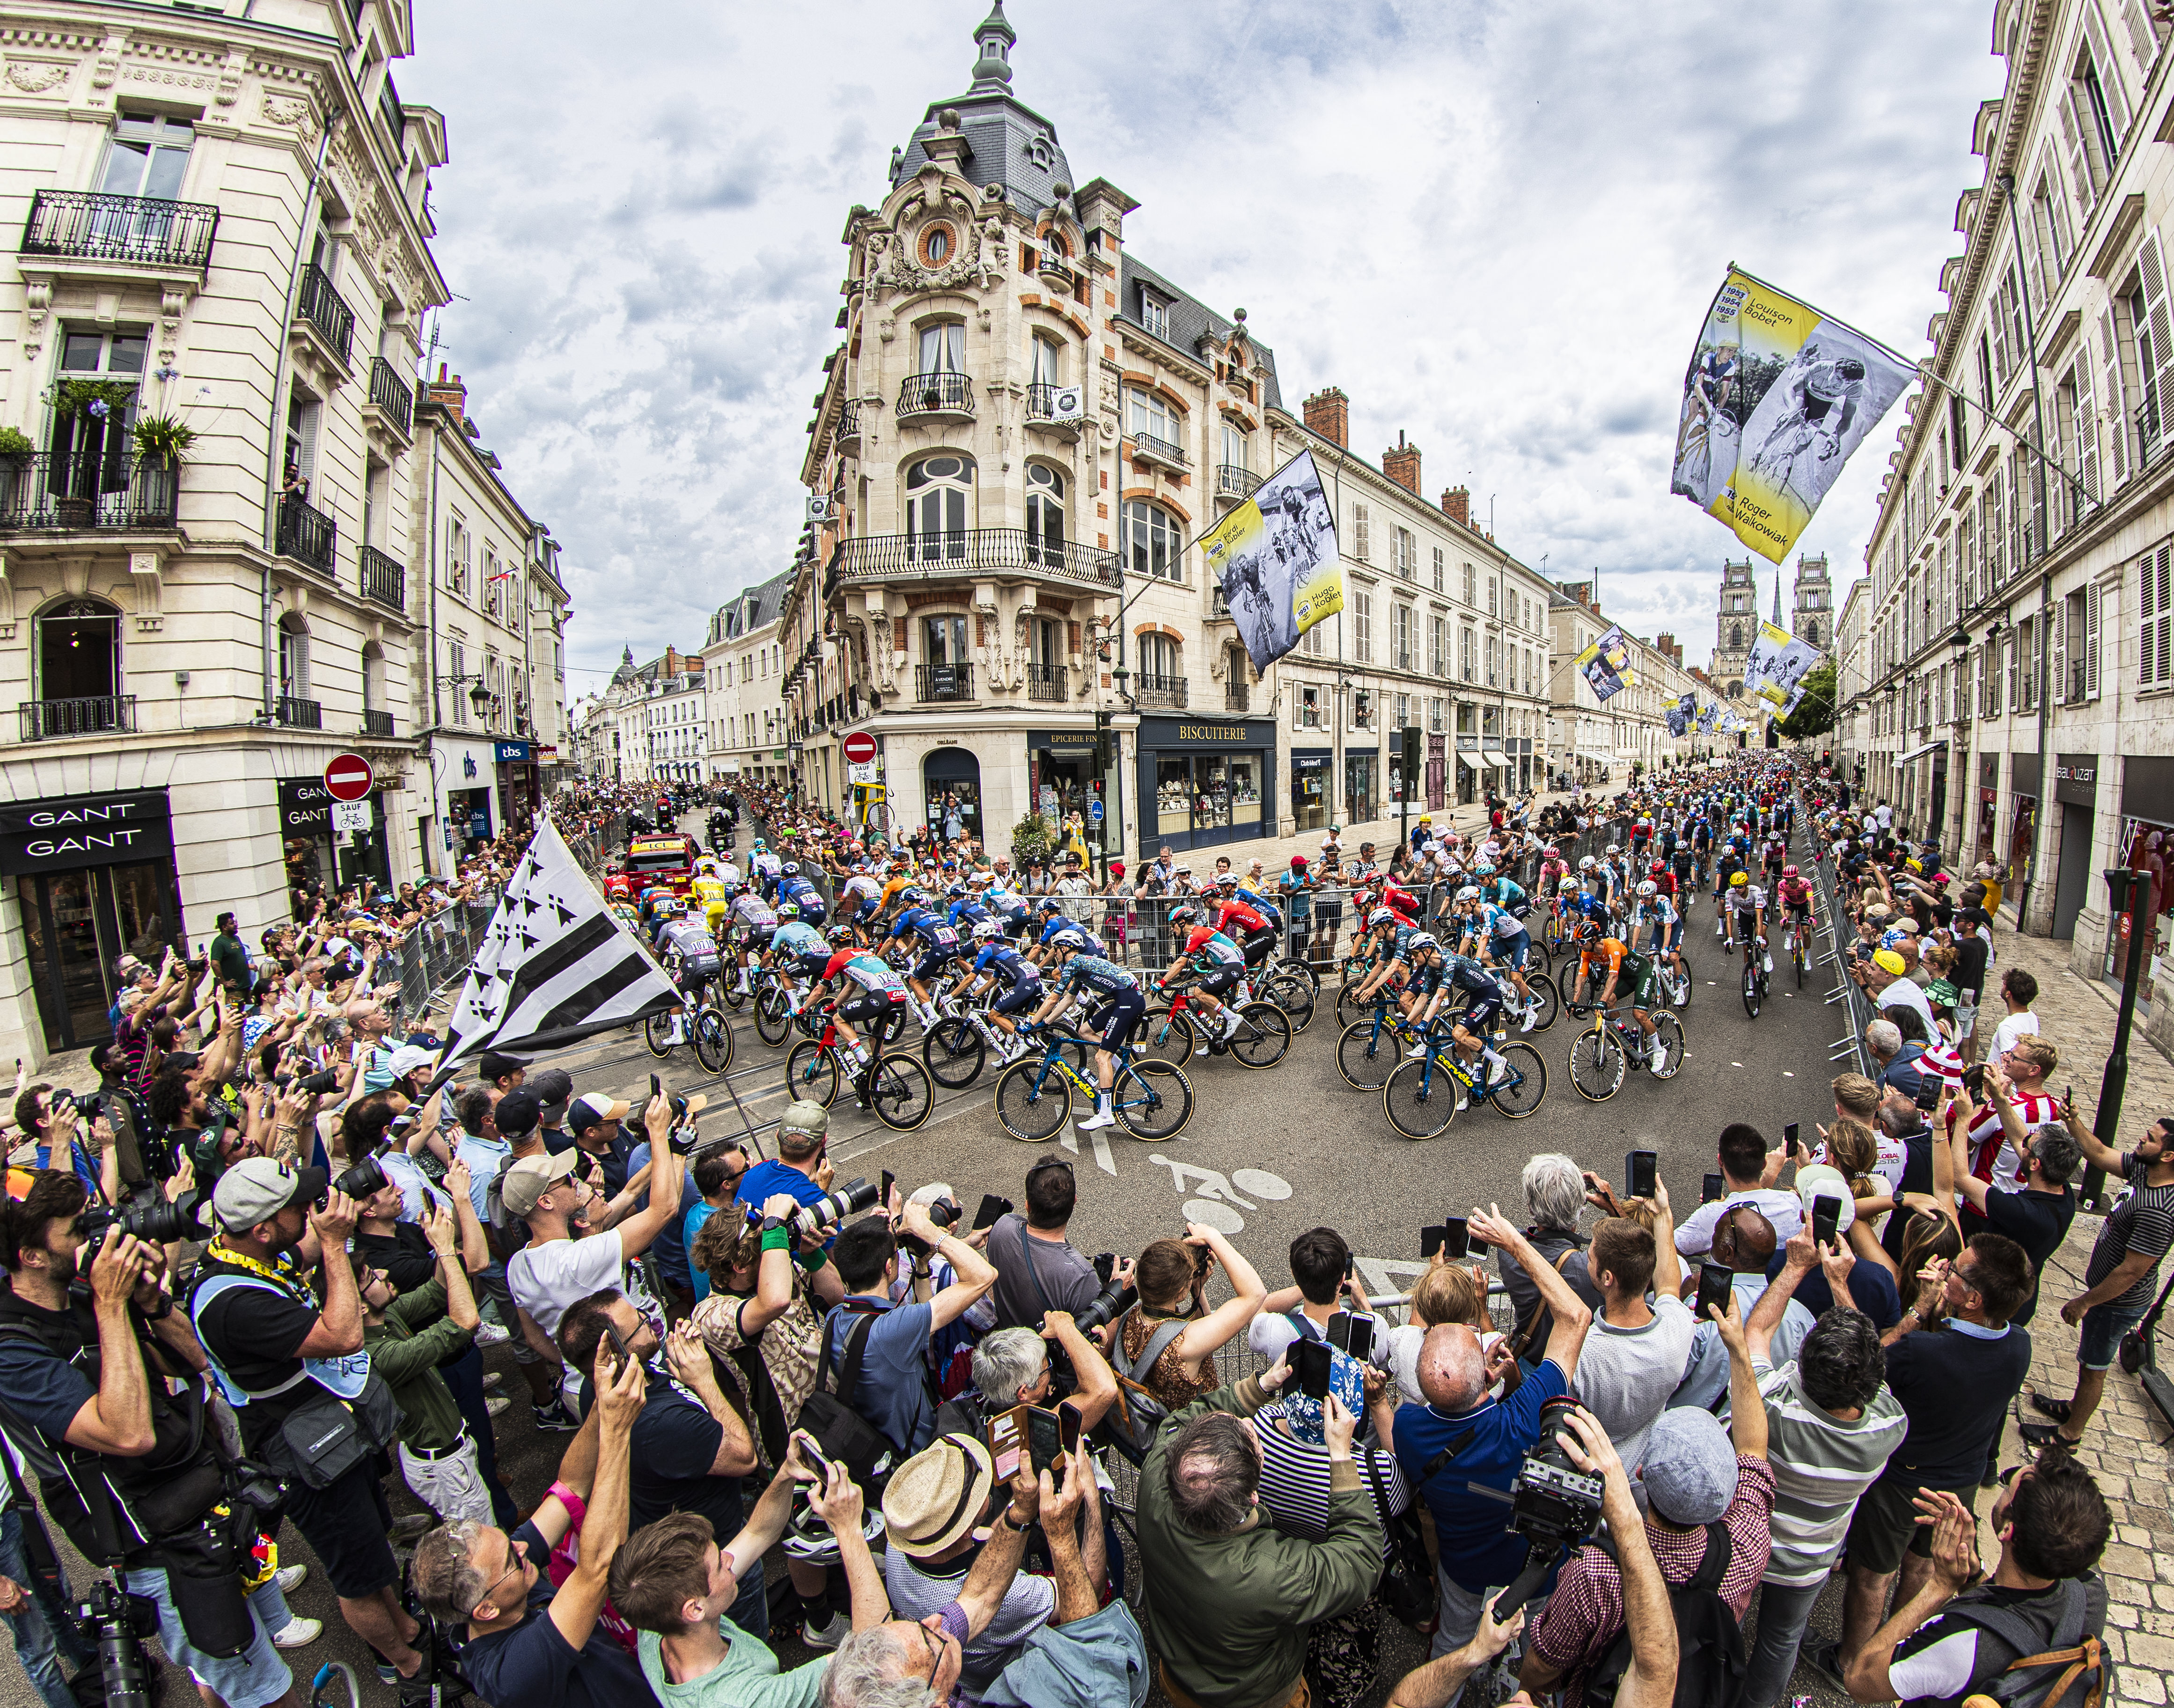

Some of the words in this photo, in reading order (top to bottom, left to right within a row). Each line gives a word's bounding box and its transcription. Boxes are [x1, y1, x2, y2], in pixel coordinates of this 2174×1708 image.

[1726, 286, 1747, 300] 1953
[1720, 295, 1741, 308] 1954
[1715, 304, 1737, 317] 1955
[1744, 306, 1777, 328] Bobet
[1750, 298, 1793, 325] Louison
[1740, 497, 1772, 520] Roger
[1223, 523, 1239, 540] Ferdi
[1735, 509, 1788, 546] Walkowiak
[1226, 527, 1246, 546] Kübler
[1209, 543, 1223, 556] 1950
[1311, 585, 1334, 602] Hugo
[1314, 590, 1342, 609] Koblet
[1297, 604, 1310, 616] 1951
[1768, 687, 1780, 698] Fausto
[1179, 726, 1246, 740] BISCUITERIE
[503, 746, 521, 758] tbs
[372, 780, 397, 788] NT
[298, 788, 327, 799] GAN
[29, 803, 135, 826] GANT
[289, 808, 328, 824] GANT
[471, 811, 484, 820] tbs
[26, 829, 142, 856] GANT
[965, 913, 980, 924] Groupa
[1235, 914, 1256, 924] ARKEA
[913, 927, 932, 941] Groupama
[939, 930, 949, 940] 98
[693, 941, 705, 950] 107
[1212, 945, 1225, 956] SOLAR
[995, 960, 1016, 979] Groupama
[1468, 969, 1485, 982] BETCITY
[852, 972, 867, 982] SOLAR
[1093, 975, 1117, 988] BETCITY
[1207, 972, 1223, 984] lotto
[1640, 977, 1651, 998] Jayco
[1000, 992, 1010, 1002] FDJ
[1474, 1003, 1485, 1014] VISMA
[1105, 1016, 1115, 1031] VISMA
[1184, 1009, 1213, 1040] ORBEA
[1653, 1012, 1679, 1025] CADEX
[1398, 1060, 1415, 1071] RESERVE
[1438, 1055, 1474, 1088] cervélo
[1572, 1039, 1584, 1082] CADEX
[1612, 1047, 1624, 1091] CADEX
[1057, 1061, 1095, 1098] cervélo
[1176, 1070, 1191, 1092] RESERVE
[1428, 1125, 1445, 1136] RESERVE
[1526, 1476, 1540, 1485] SONY
